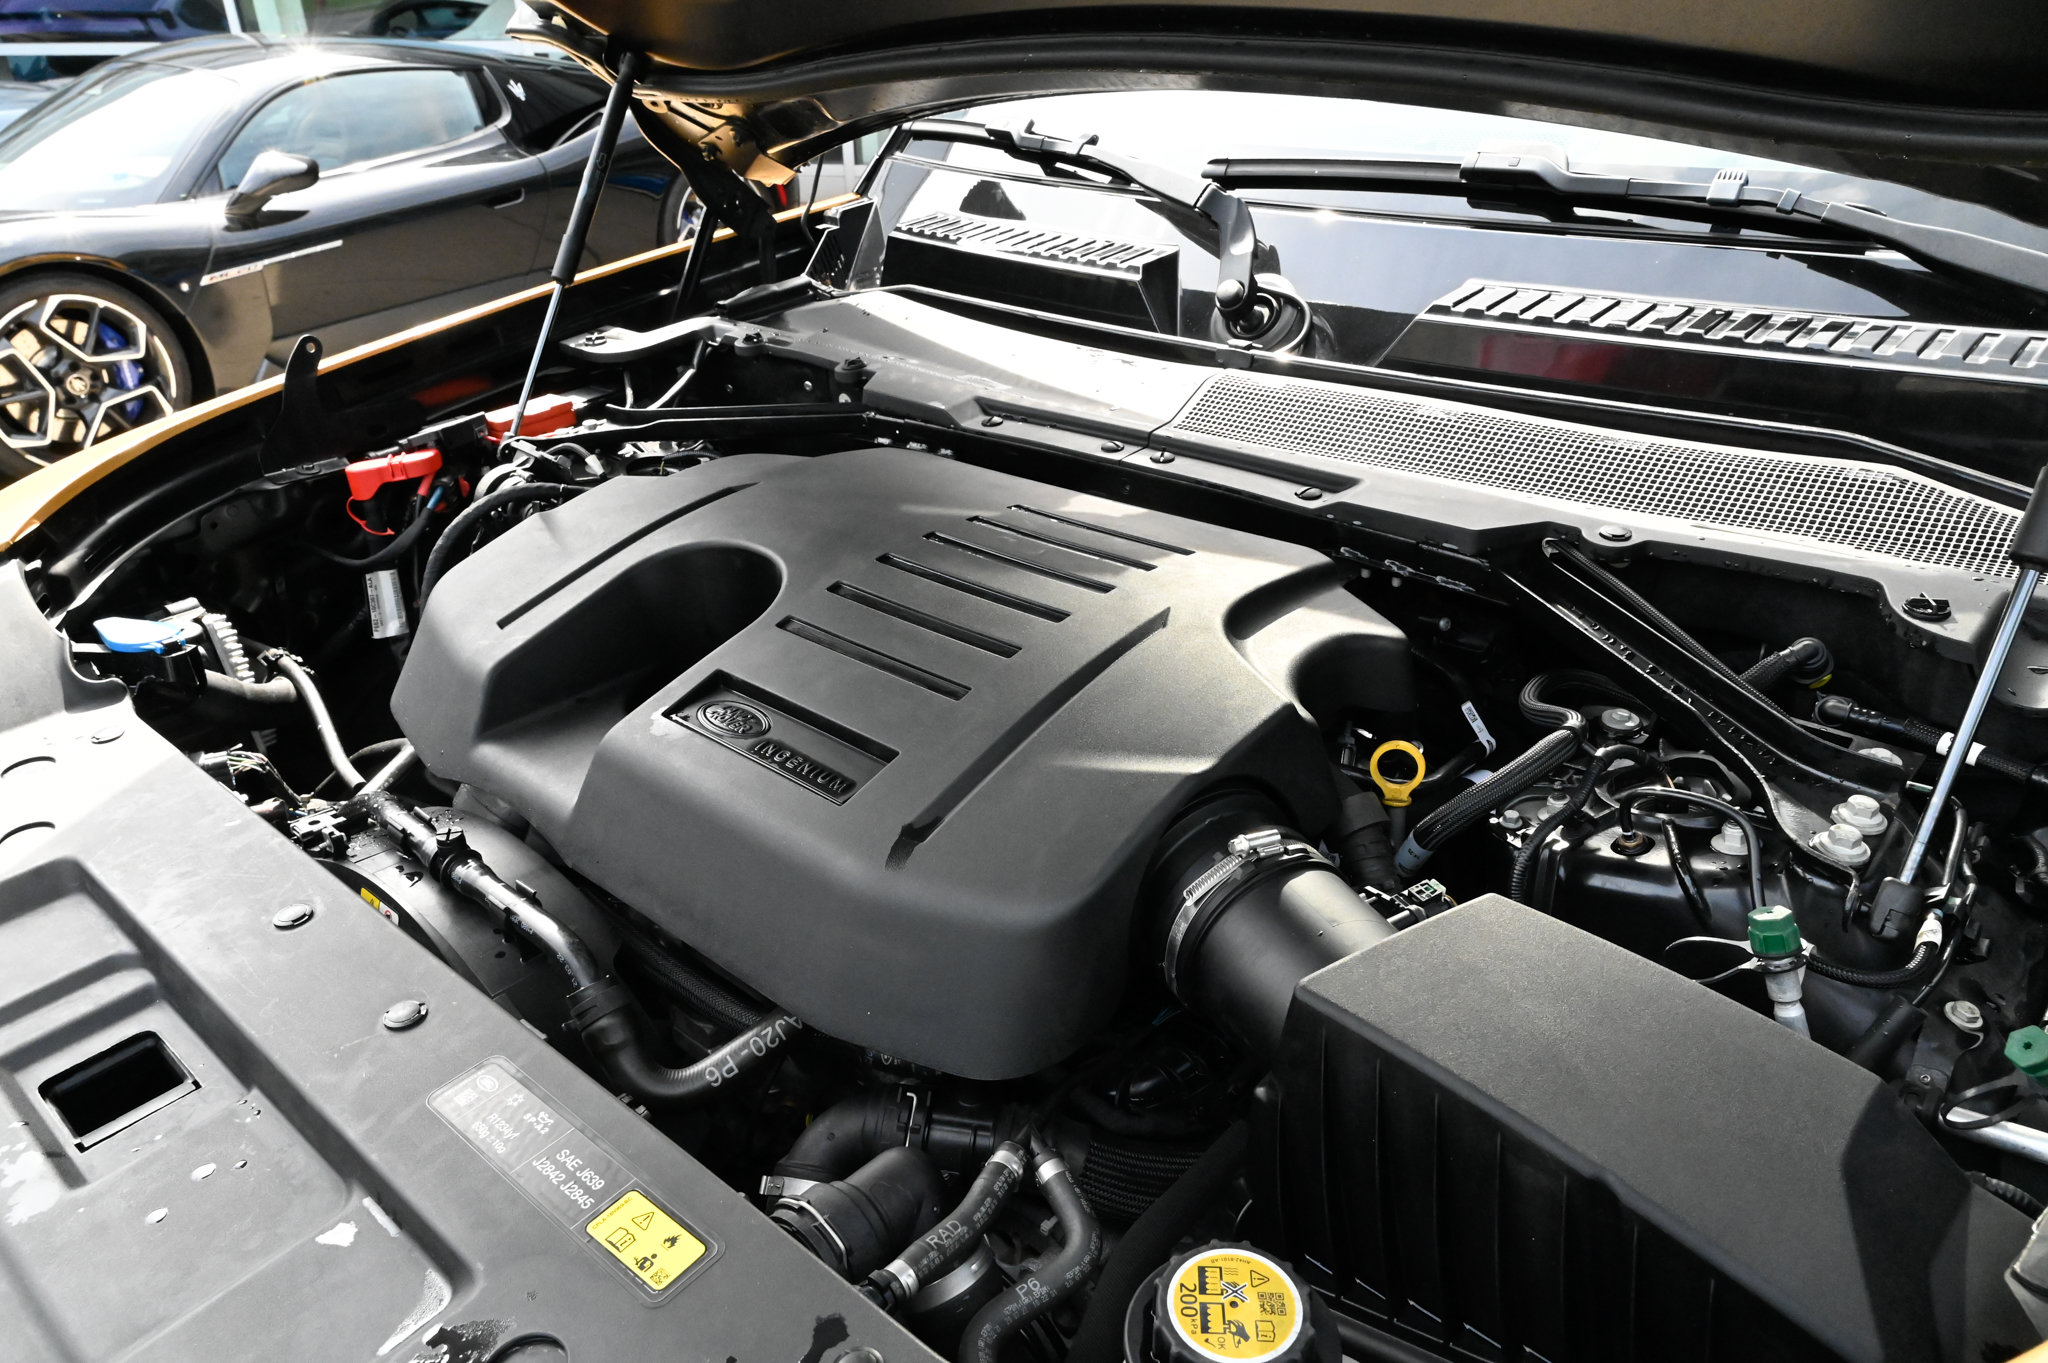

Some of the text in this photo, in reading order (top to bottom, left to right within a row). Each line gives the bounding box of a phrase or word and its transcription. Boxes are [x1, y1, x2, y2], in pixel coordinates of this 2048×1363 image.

[754, 741, 846, 793] INGENIUM
[486, 1113, 521, 1140] R1234yf
[532, 1156, 595, 1209] J2842 J2845
[556, 1149, 605, 1191] SAE J639
[926, 1220, 961, 1249] RAD
[1015, 1277, 1041, 1301] P6
[1217, 1336, 1227, 1350] OK
